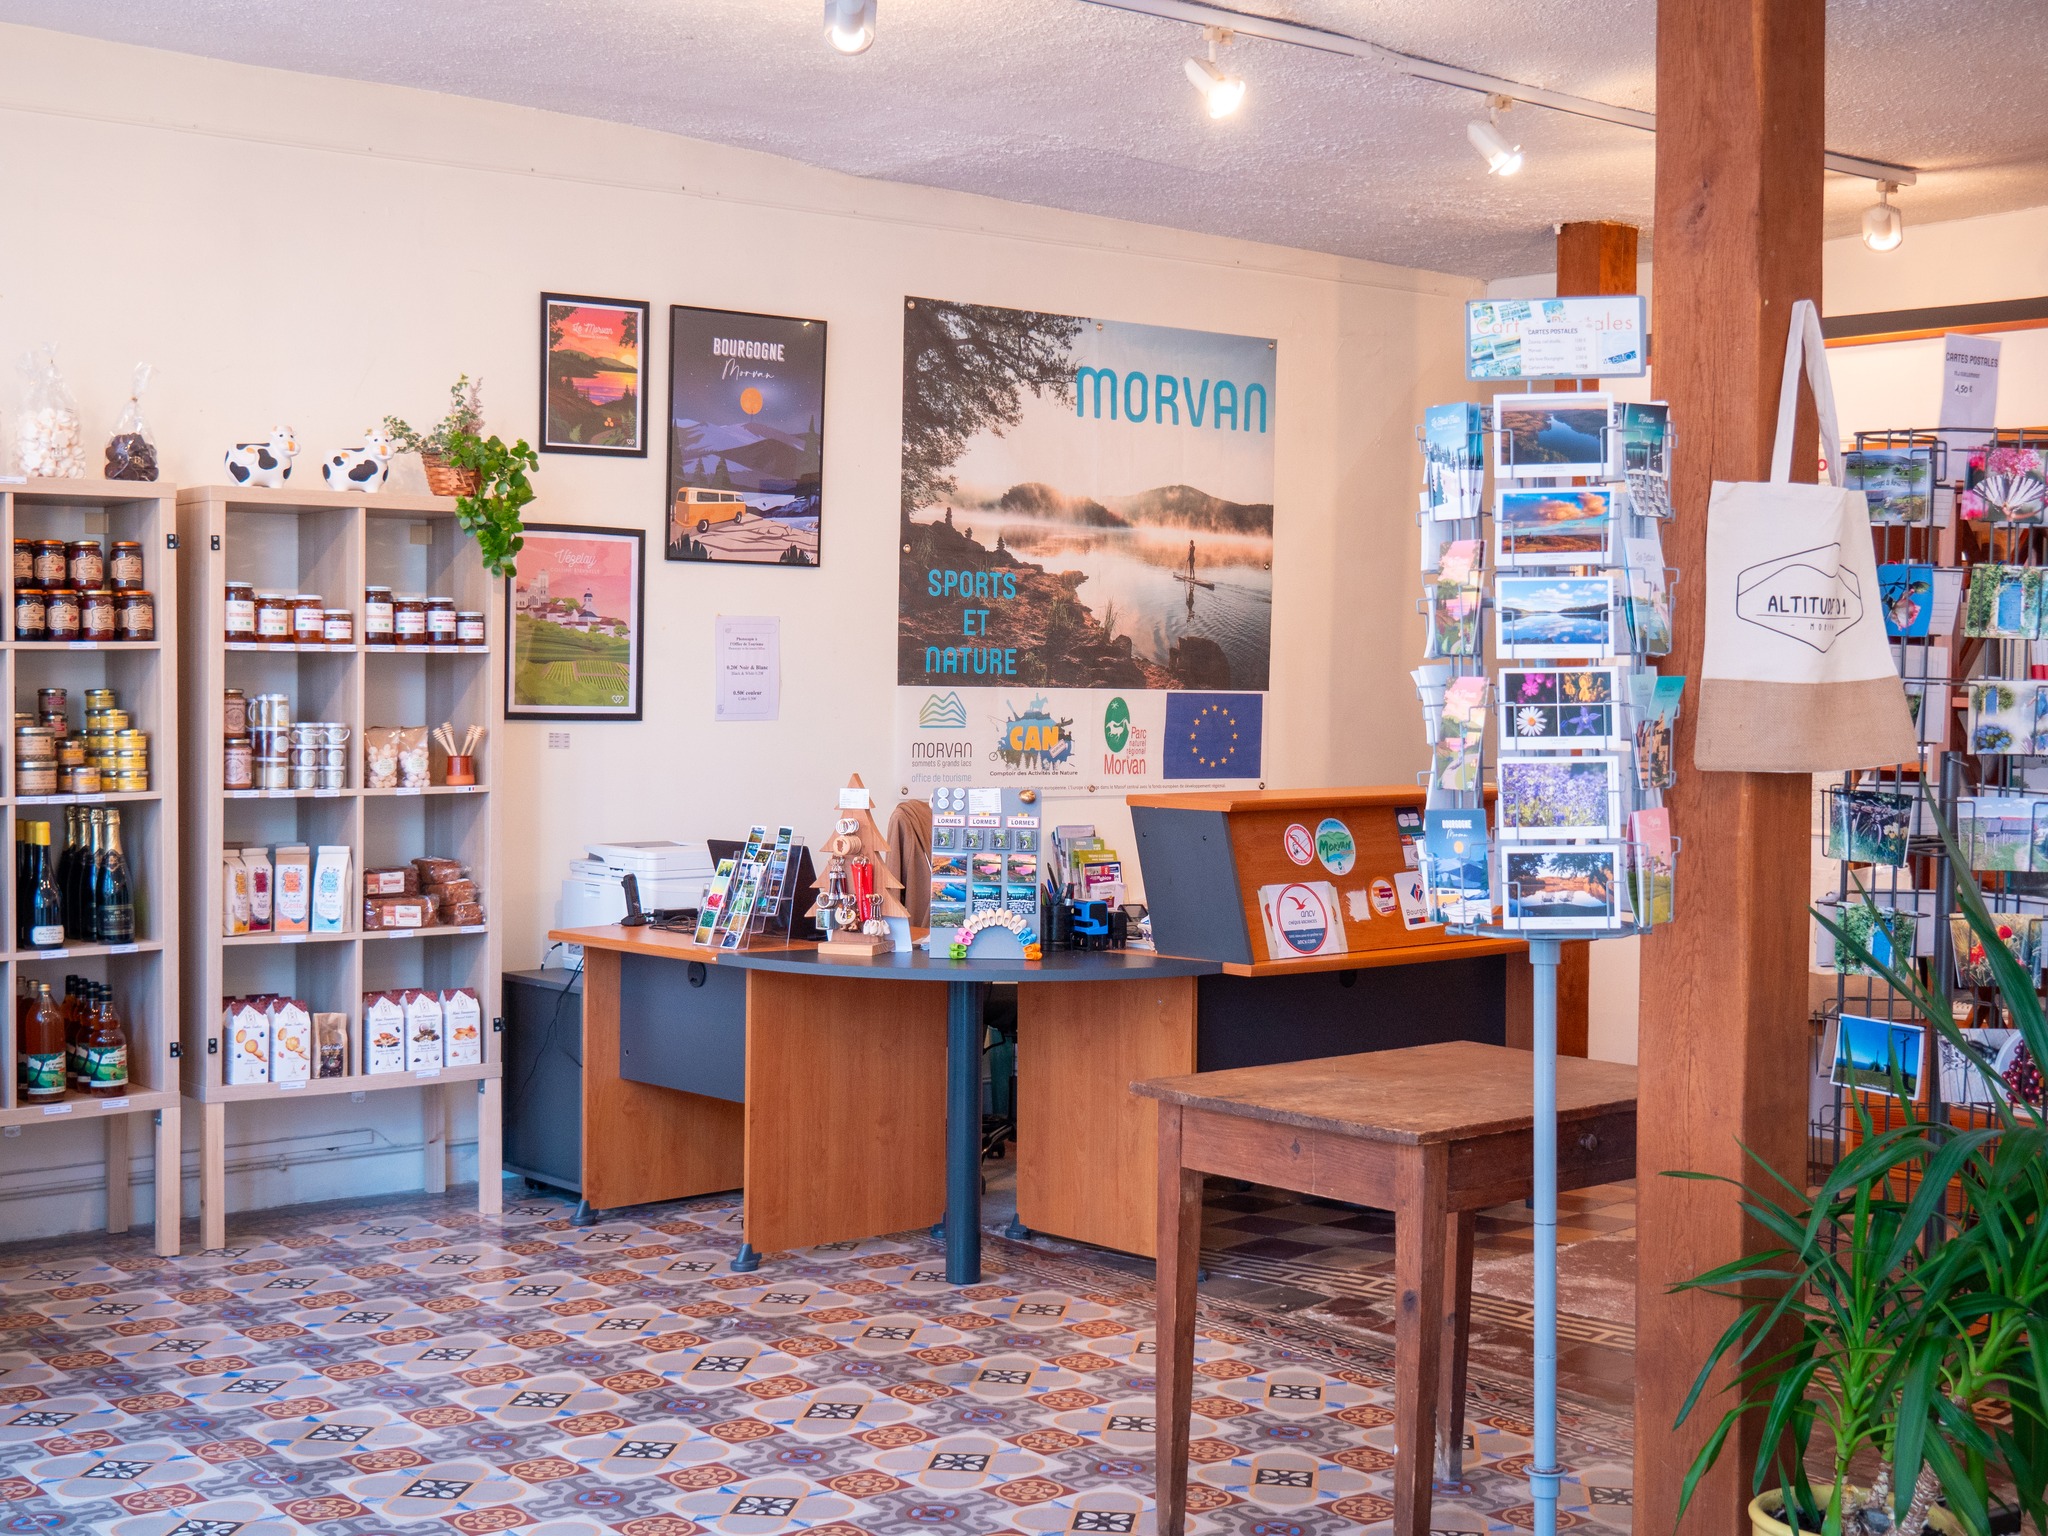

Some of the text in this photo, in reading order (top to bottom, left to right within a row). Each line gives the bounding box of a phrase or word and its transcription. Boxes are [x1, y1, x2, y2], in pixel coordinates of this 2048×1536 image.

[583, 322, 613, 336] Morvan
[1550, 327, 1578, 335] POSTALES
[713, 337, 785, 362] BOURGOGNE
[1945, 352, 1999, 368] CARTES POSTALES
[721, 358, 775, 381] Morvan
[1076, 366, 1268, 434] MORVAN
[927, 568, 1017, 600] SPORTS
[962, 608, 990, 637] ET
[925, 645, 1018, 676] NATURE
[1009, 725, 1060, 751] CAN
[1130, 726, 1147, 739] Parc
[911, 742, 973, 759] MORVAN
[1126, 747, 1147, 755] régional
[1128, 739, 1147, 747] naturel
[911, 759, 936, 767] sommets
[942, 759, 960, 769] grands
[960, 759, 972, 767] lacs
[1103, 754, 1147, 775] Morvan
[911, 773, 972, 783] office de tourisme
[989, 770, 1017, 778] Comptoir
[972, 818, 997, 826] LORMES
[1318, 839, 1352, 863] MORVAN
